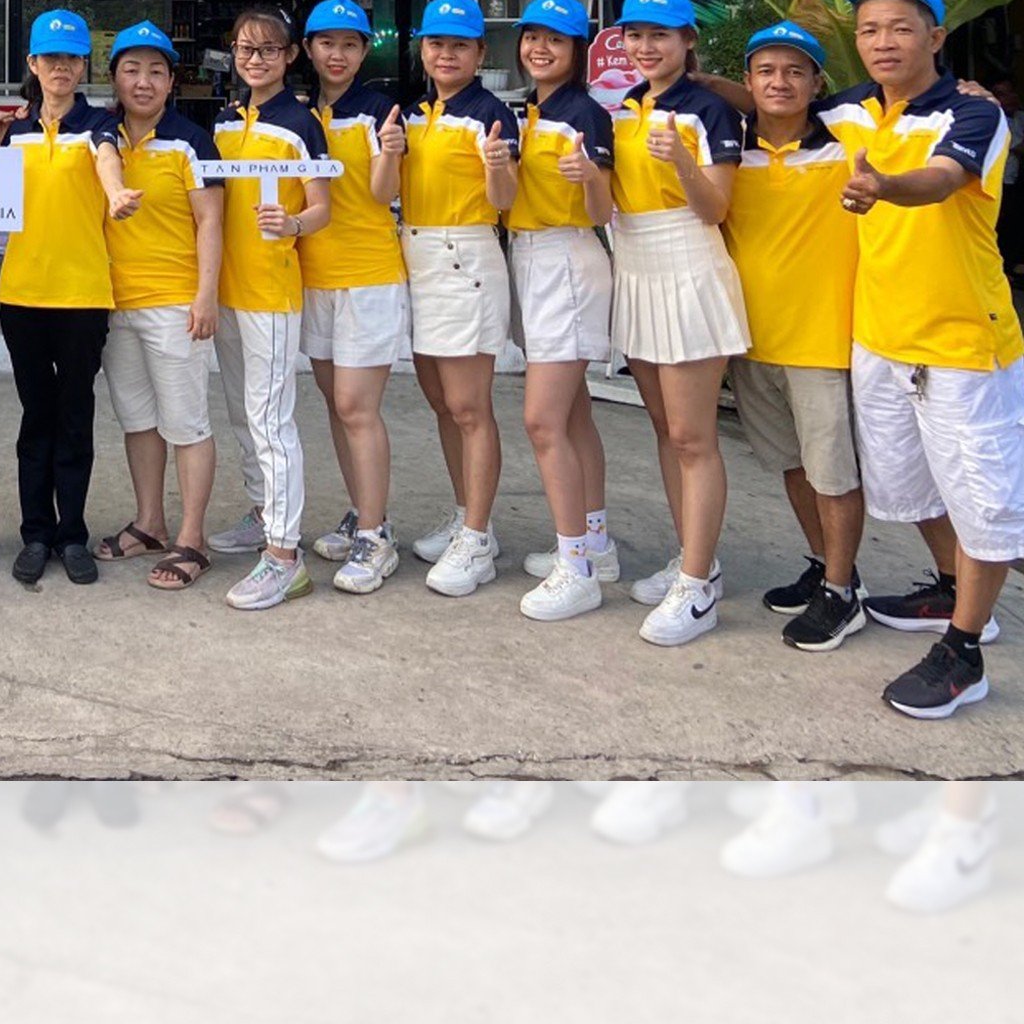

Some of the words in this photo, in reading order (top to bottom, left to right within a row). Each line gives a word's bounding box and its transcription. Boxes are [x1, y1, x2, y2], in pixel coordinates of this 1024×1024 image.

[202, 164, 241, 173] TAN
[249, 164, 289, 173] PHAM
[297, 164, 338, 173] GIA
